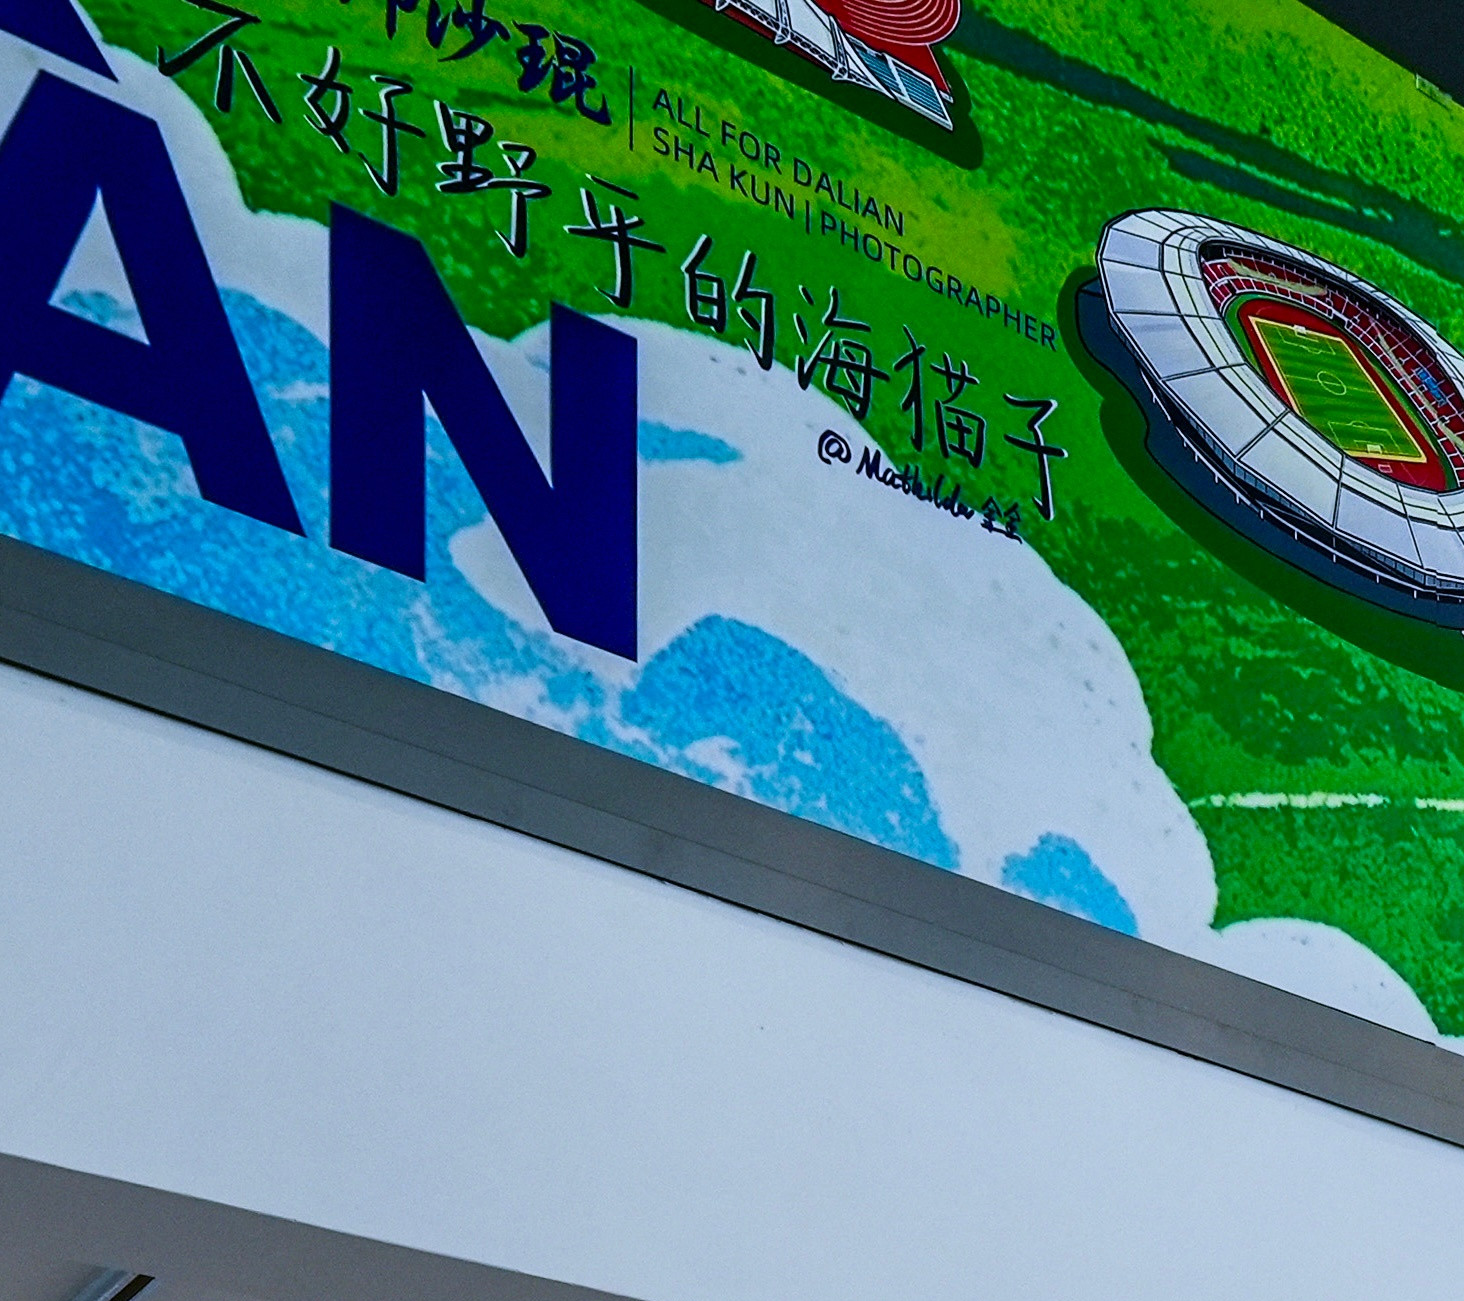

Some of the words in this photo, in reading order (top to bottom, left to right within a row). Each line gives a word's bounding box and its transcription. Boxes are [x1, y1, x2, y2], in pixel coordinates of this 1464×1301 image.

[652, 126, 720, 183] SHA
[729, 164, 796, 221] KUN
[821, 209, 1058, 352] PHOTOGRAPHER
[653, 88, 711, 139] ALL
[721, 119, 783, 176] FOR
[793, 156, 906, 237] DALIAN
